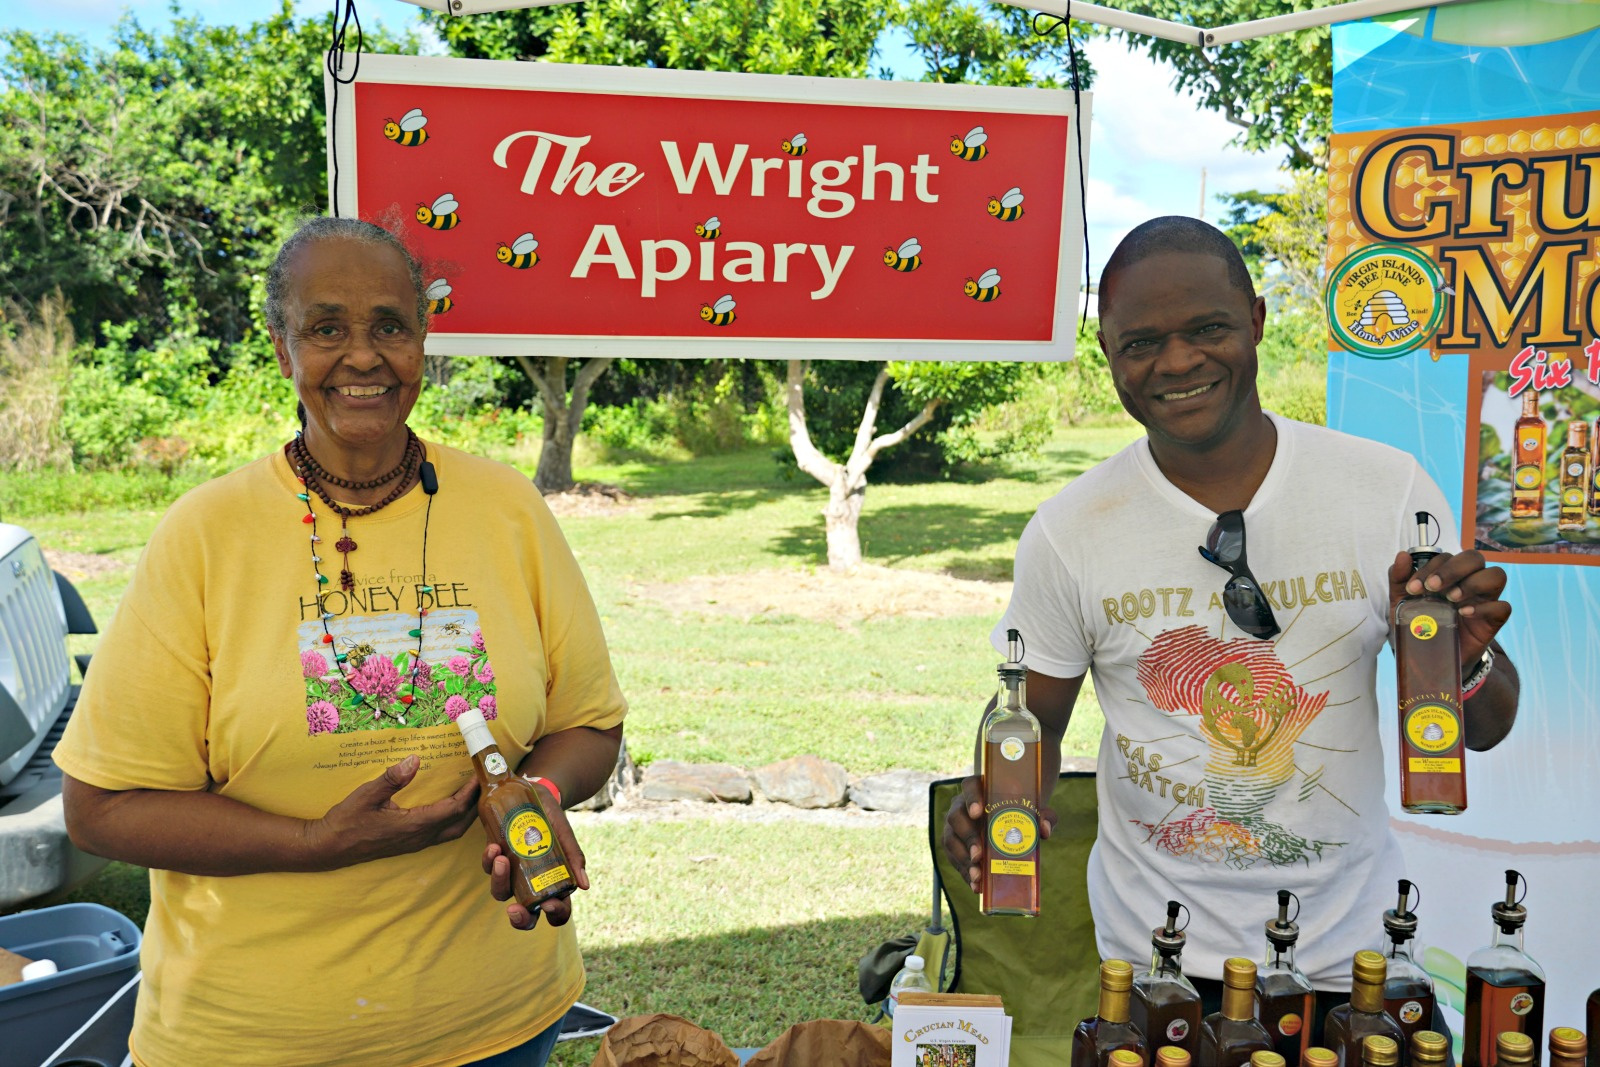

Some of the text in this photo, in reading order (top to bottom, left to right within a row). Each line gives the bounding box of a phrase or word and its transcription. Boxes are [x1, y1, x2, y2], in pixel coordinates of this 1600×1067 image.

[493, 130, 940, 219] The Wright
[570, 224, 856, 300] Apiary
[1345, 259, 1425, 288] VIRGIN ISLANDS
[1358, 270, 1411, 289] BEE LINE
[1347, 319, 1419, 345] Honey Wine
[1508, 345, 1571, 397] Six
[390, 568, 423, 585] from
[428, 573, 437, 583] a
[1261, 569, 1368, 612] KULCHA
[299, 582, 473, 621] HONEY BEE
[1102, 587, 1194, 626] ROOTZ
[338, 749, 356, 758] Mind
[357, 750, 373, 758] your
[390, 745, 419, 753] beeswax
[340, 741, 363, 749] Create
[370, 738, 386, 746] buzz
[410, 733, 425, 741] life's
[1116, 733, 1163, 772] RAS
[313, 762, 337, 770] Always
[338, 759, 353, 767] find
[353, 759, 370, 768] your
[370, 758, 386, 766] way
[435, 751, 453, 759] close
[1127, 760, 1206, 808] BATCH
[904, 1019, 989, 1045] CRUCIAN MEAD
